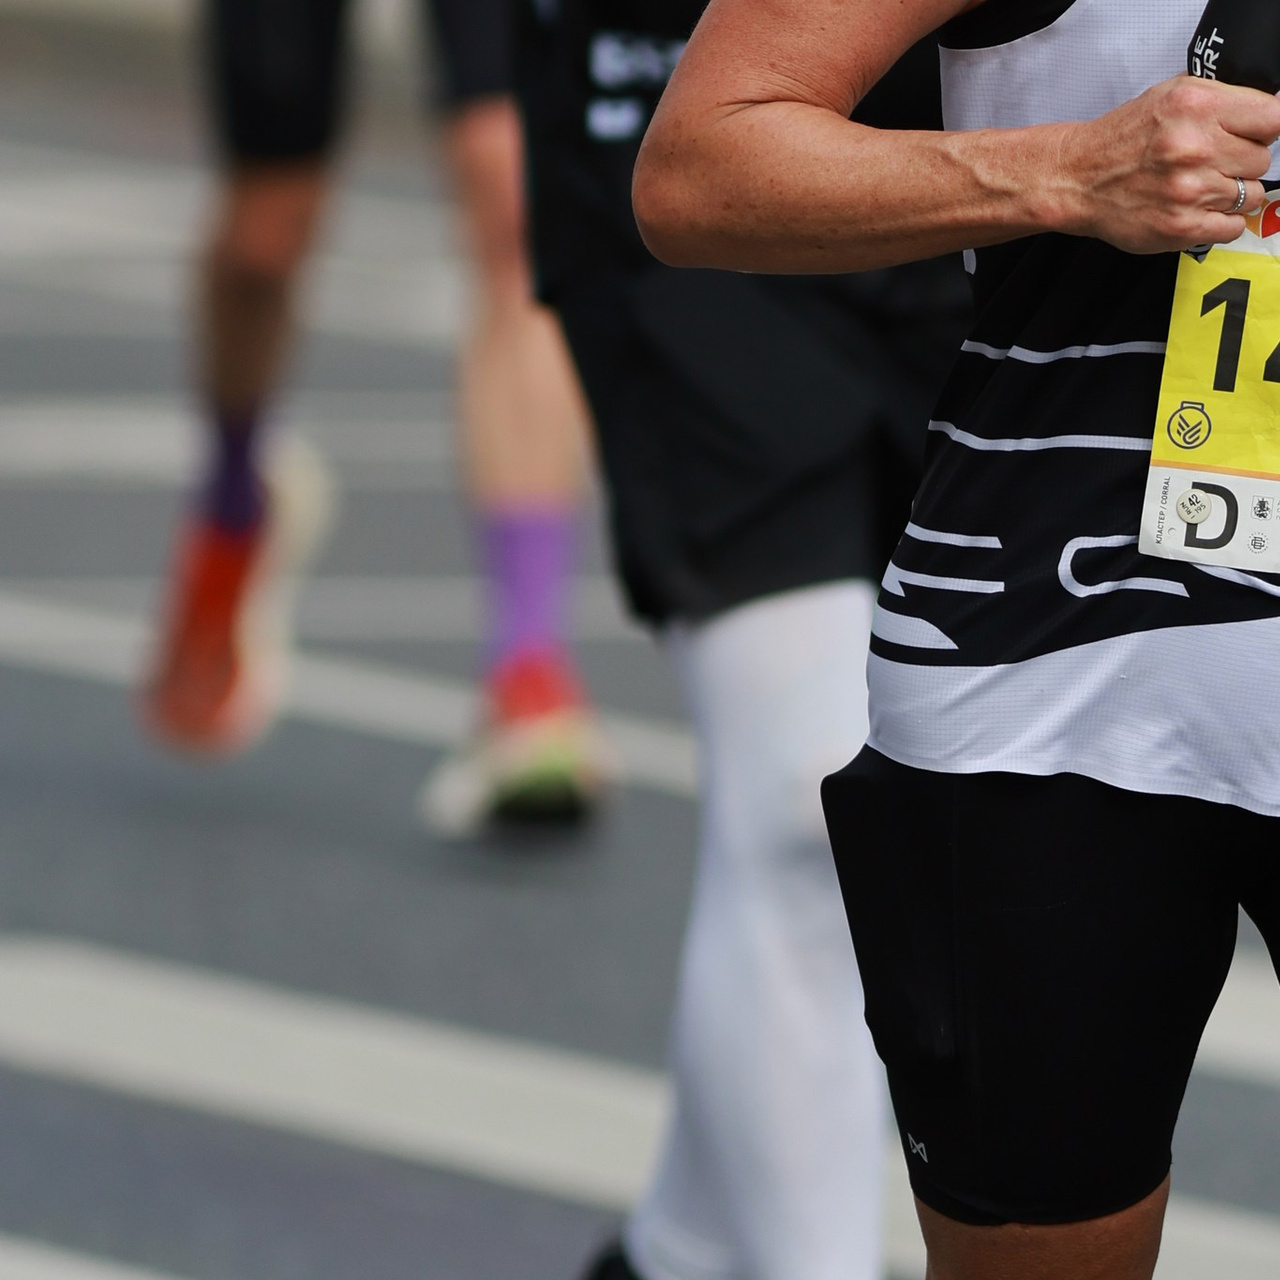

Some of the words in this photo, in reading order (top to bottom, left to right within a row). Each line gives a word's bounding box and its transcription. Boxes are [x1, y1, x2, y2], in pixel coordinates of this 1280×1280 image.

[1155, 510, 1165, 545] КЛАСТЕР
[1160, 476, 1171, 505] CORRAL
[1184, 481, 1239, 550] D
